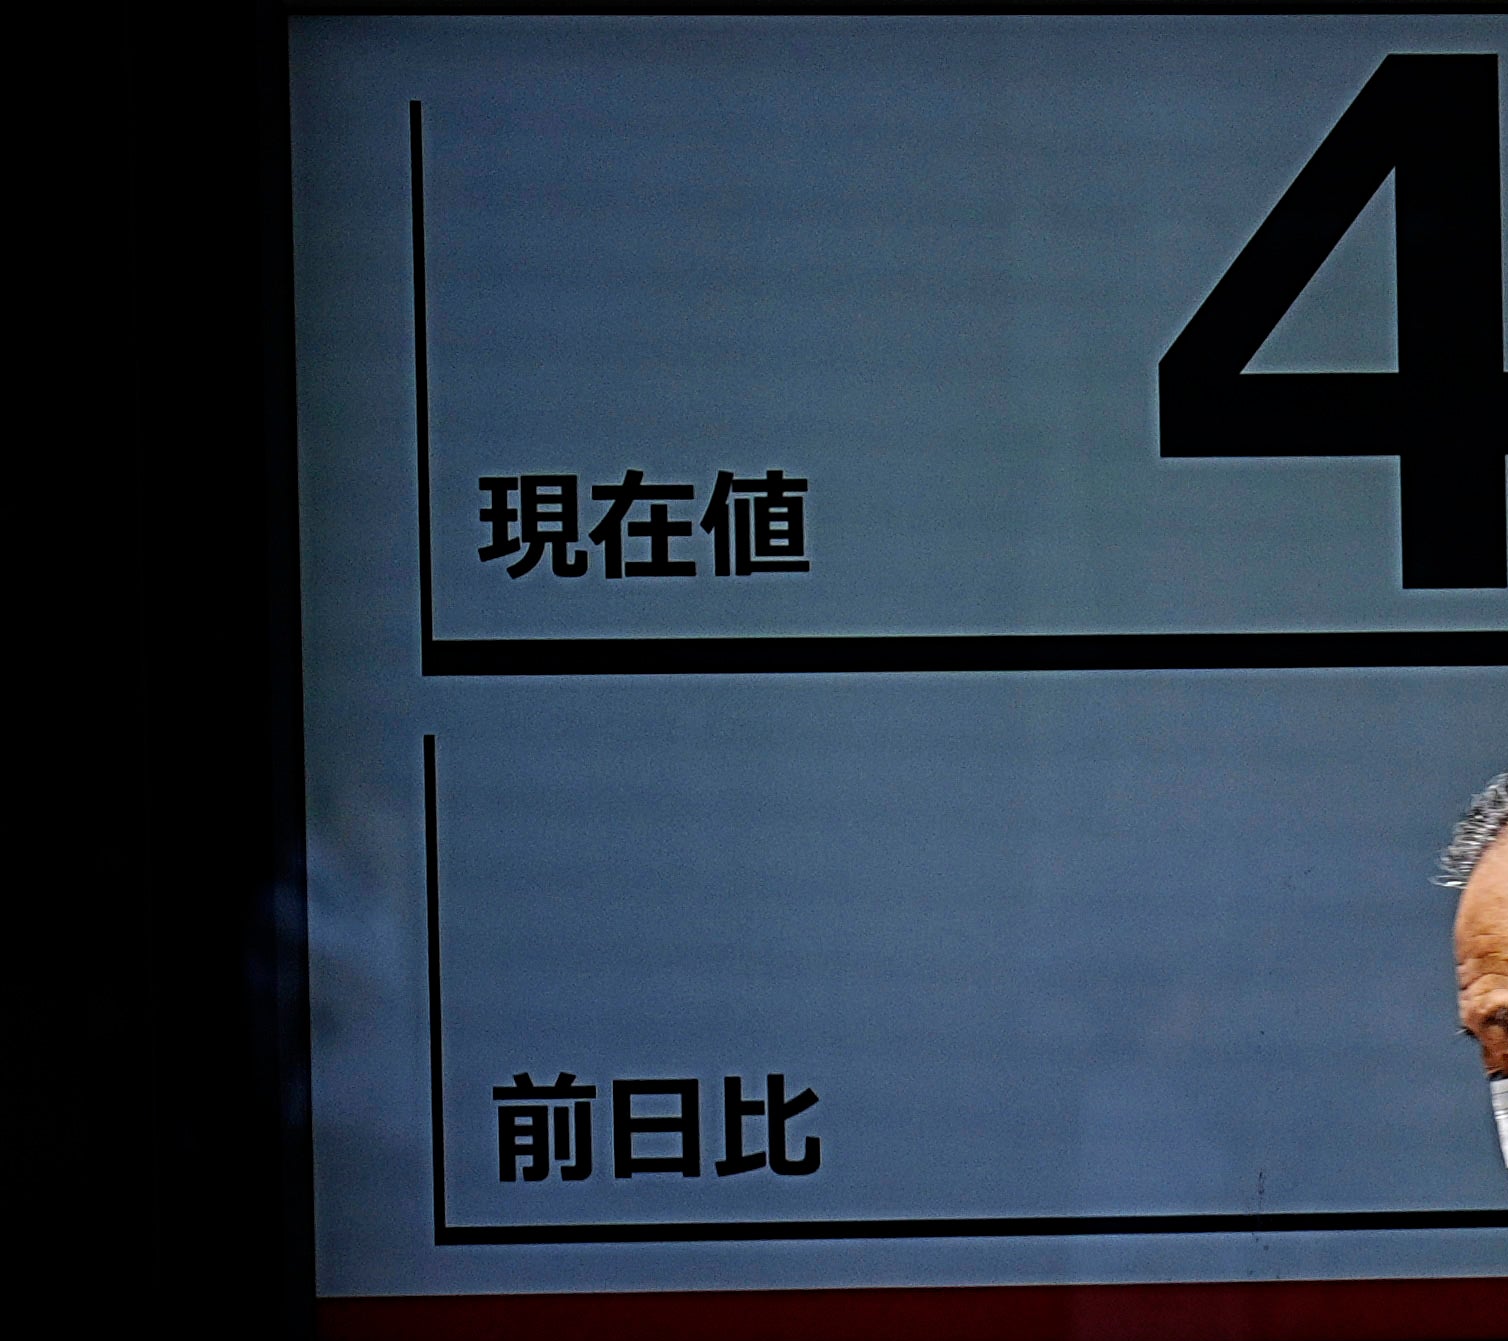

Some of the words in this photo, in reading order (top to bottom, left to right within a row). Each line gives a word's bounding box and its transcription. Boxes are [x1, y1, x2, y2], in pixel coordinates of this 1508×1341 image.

[477, 469, 811, 580] 現在値
[491, 1070, 823, 1184] 前日比
